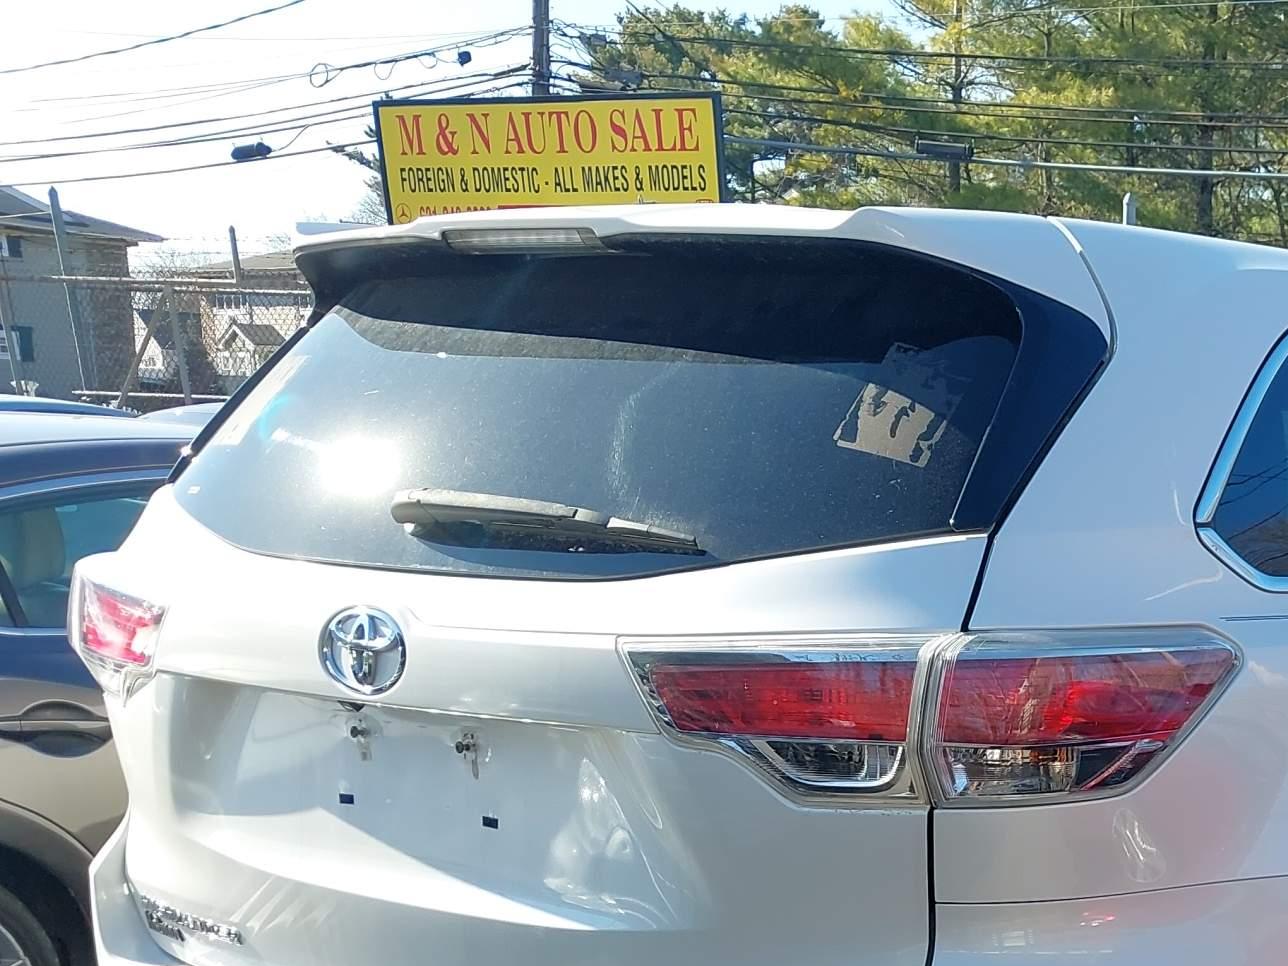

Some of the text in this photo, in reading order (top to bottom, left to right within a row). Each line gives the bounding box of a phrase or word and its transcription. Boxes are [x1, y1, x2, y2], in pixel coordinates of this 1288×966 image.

[395, 107, 700, 156] M & N AUTO SALE
[400, 166, 455, 193] FOREIGN
[460, 167, 470, 193] &
[472, 166, 540, 193] DOMESTIC
[554, 166, 578, 193] ALL
[581, 164, 629, 193] MAKES
[634, 165, 644, 192] &
[648, 163, 707, 192] MODELS
